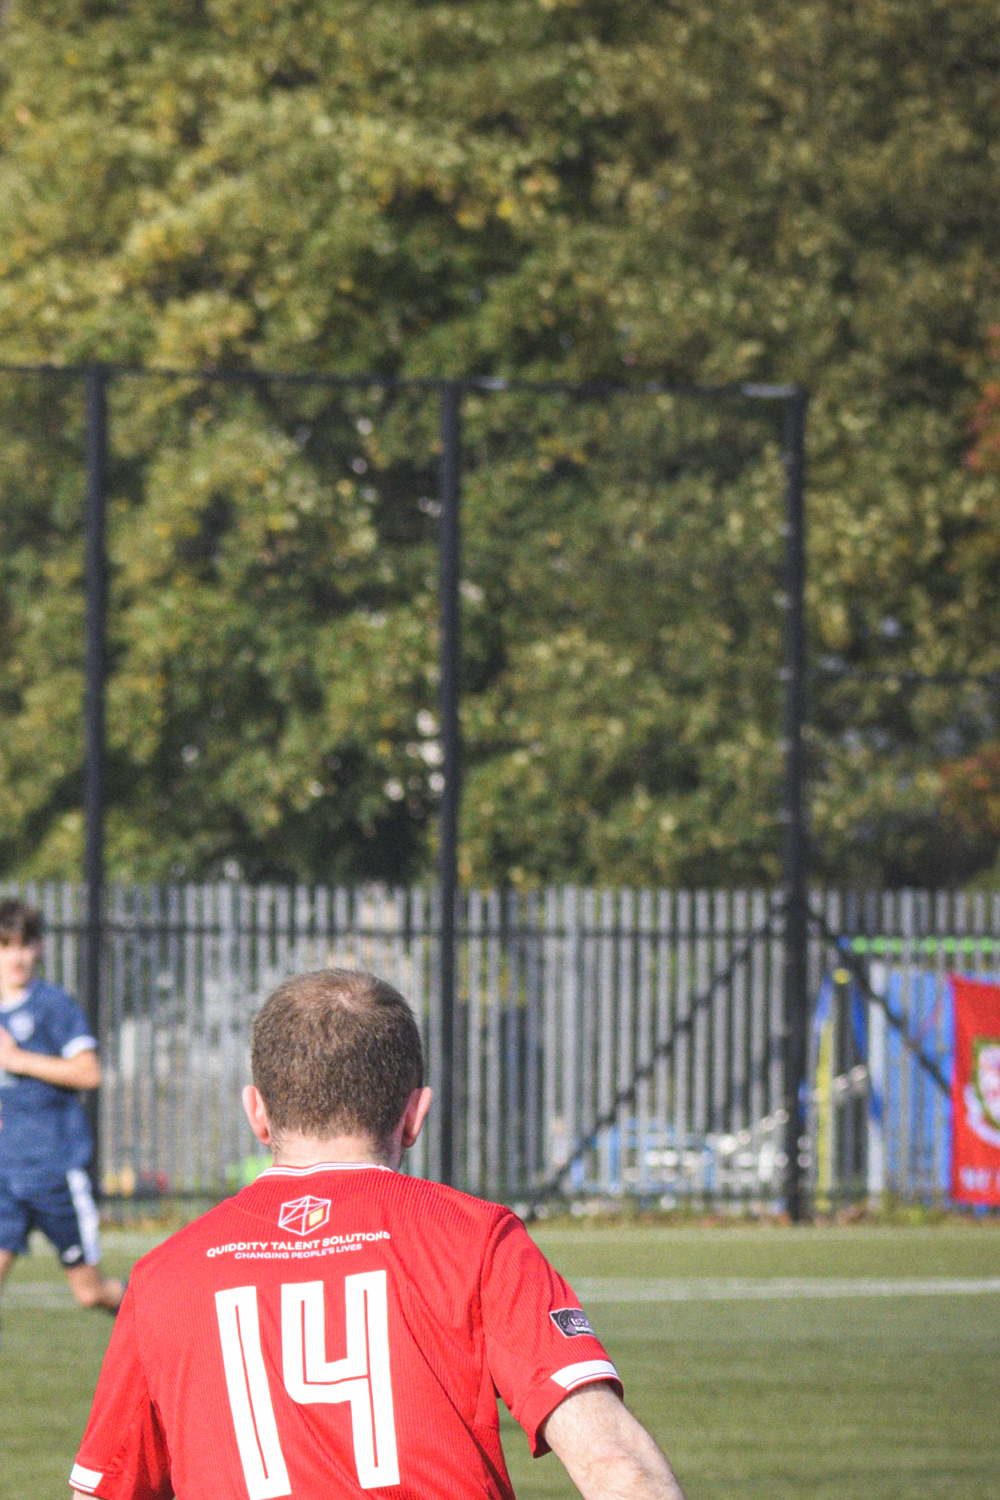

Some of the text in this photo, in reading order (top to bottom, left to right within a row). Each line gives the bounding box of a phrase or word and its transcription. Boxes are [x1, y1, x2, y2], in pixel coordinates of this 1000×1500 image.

[206, 1230, 391, 1258] QUIDDITY TALENT SOLUTIONS
[234, 1243, 362, 1259] CHANGING PEOPLE'S LIVES
